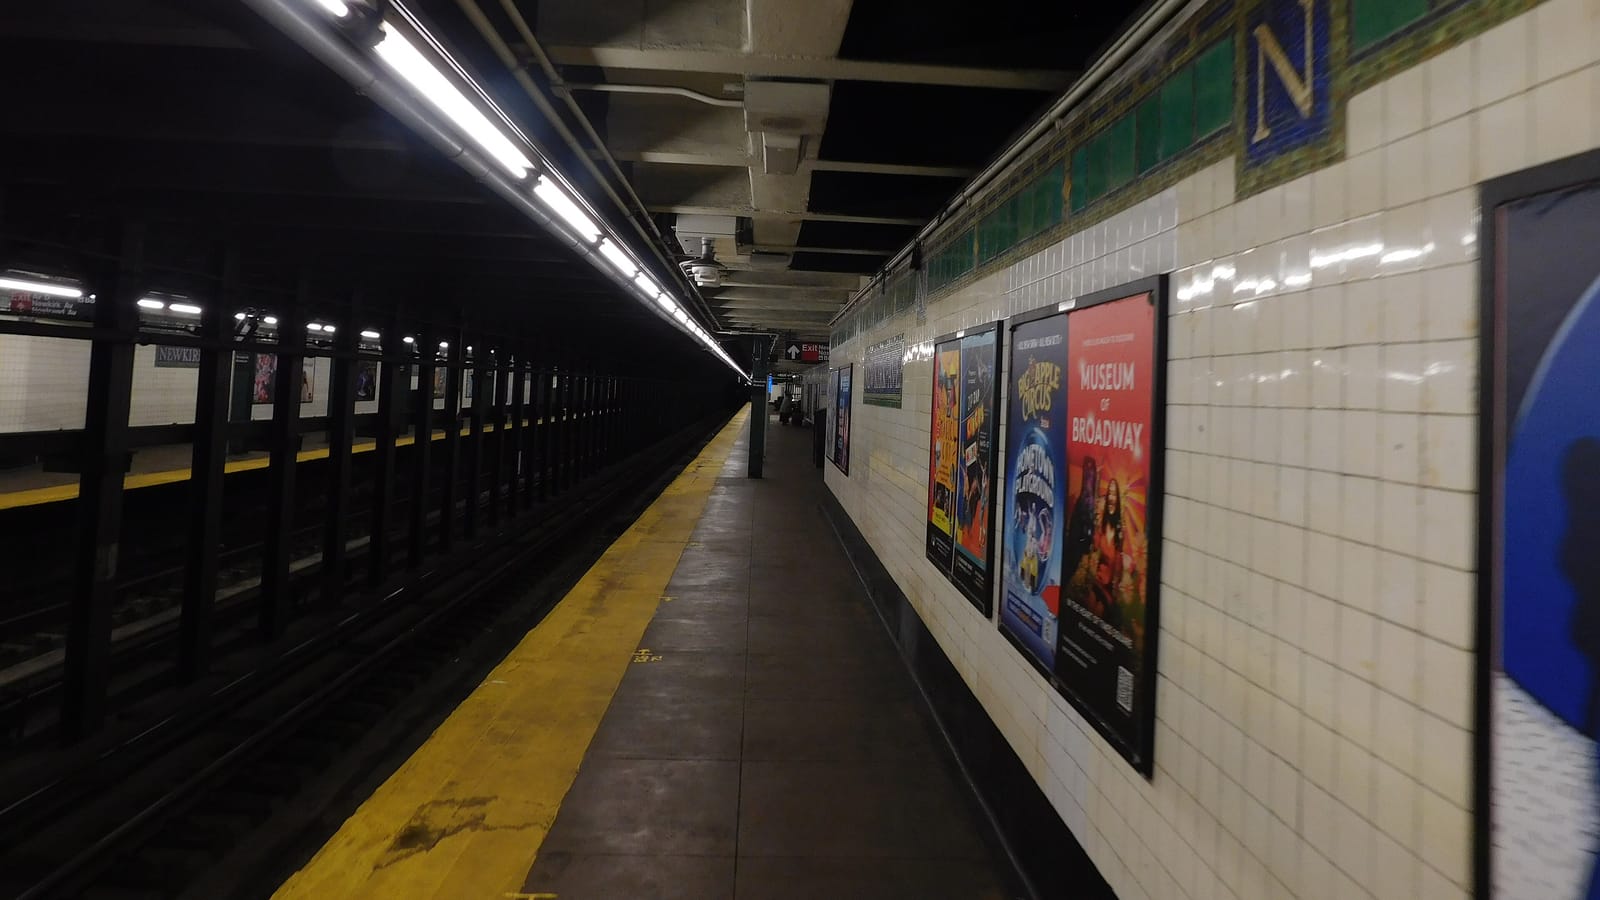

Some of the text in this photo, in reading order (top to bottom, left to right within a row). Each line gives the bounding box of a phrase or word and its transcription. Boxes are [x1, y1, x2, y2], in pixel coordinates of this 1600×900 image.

[1251, 0, 1315, 144] N
[802, 343, 818, 352] Exit
[1034, 361, 1061, 390] APPLE
[1079, 361, 1135, 391] MUSEUM
[1022, 384, 1052, 422] CIRCUS
[1100, 398, 1110, 411] OF
[1071, 414, 1143, 455] BROADWAY
